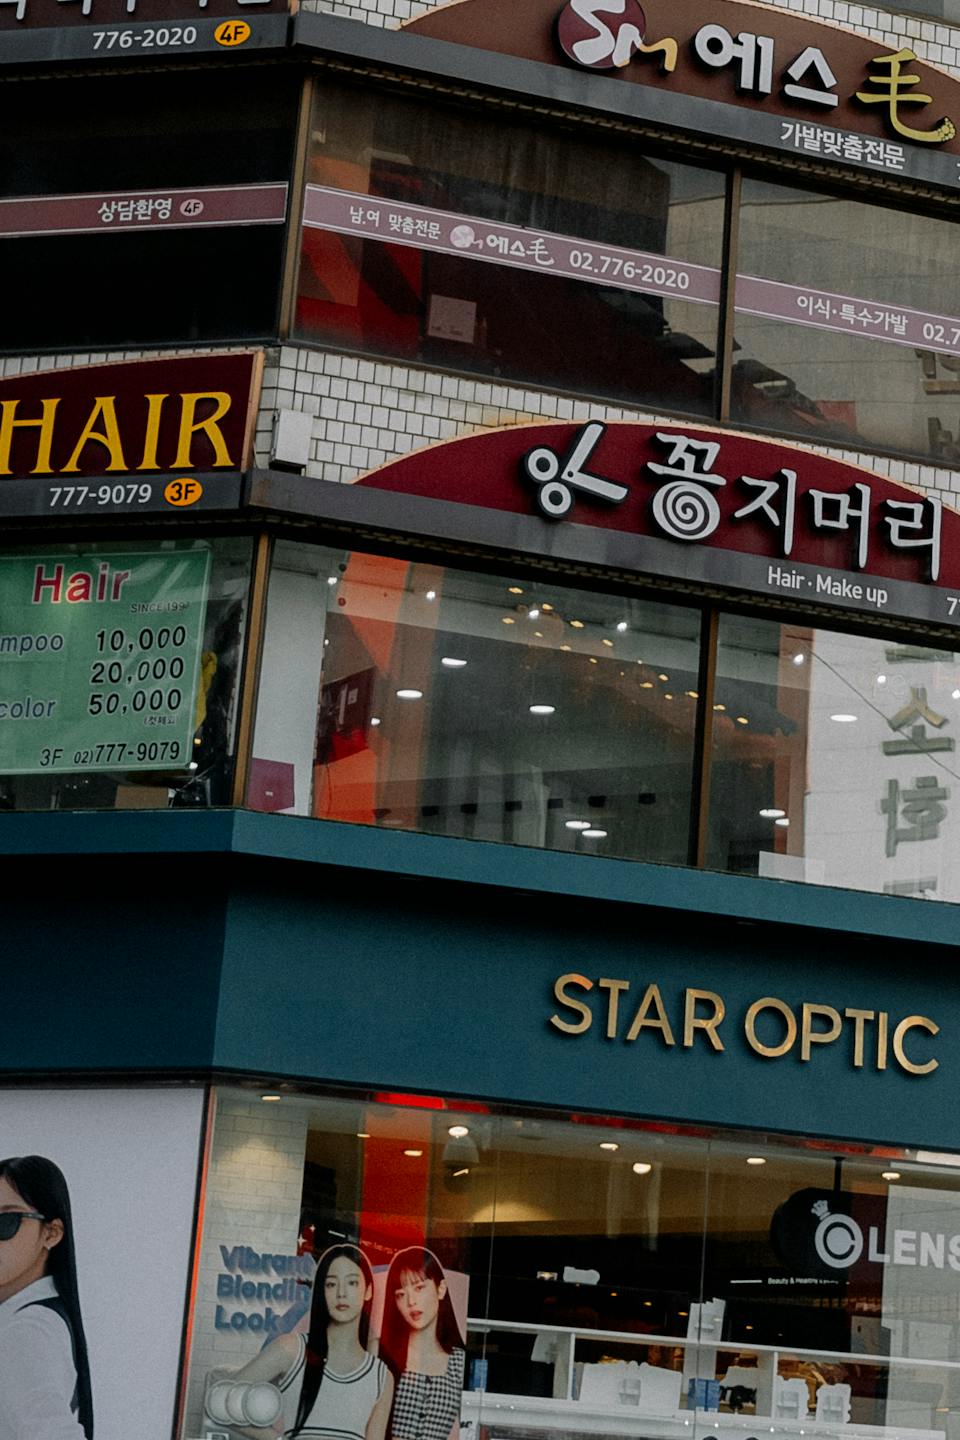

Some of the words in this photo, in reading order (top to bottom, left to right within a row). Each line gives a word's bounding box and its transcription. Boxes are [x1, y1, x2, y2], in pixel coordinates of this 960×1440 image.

[92, 26, 198, 50] 776-2020
[218, 23, 246, 44] 4F
[780, 122, 905, 171] 가발맞춤전문
[98, 197, 172, 223] 상담환영
[389, 213, 441, 240] 맞춤전문
[569, 249, 690, 290] 02.776-2020
[0, 391, 235, 475] HAIR
[50, 483, 152, 507] 777-9079
[169, 481, 197, 502] 3F
[647, 431, 942, 582] 꽁지머리
[31, 562, 130, 604] Hair
[816, 573, 862, 600] Make
[866, 587, 888, 605] up
[96, 626, 186, 653] 10,000
[91, 658, 184, 685] 20,000
[89, 689, 182, 715] 50,000
[40, 748, 64, 766] 3F
[550, 973, 725, 1051] STAR
[745, 997, 941, 1075] OPTIC
